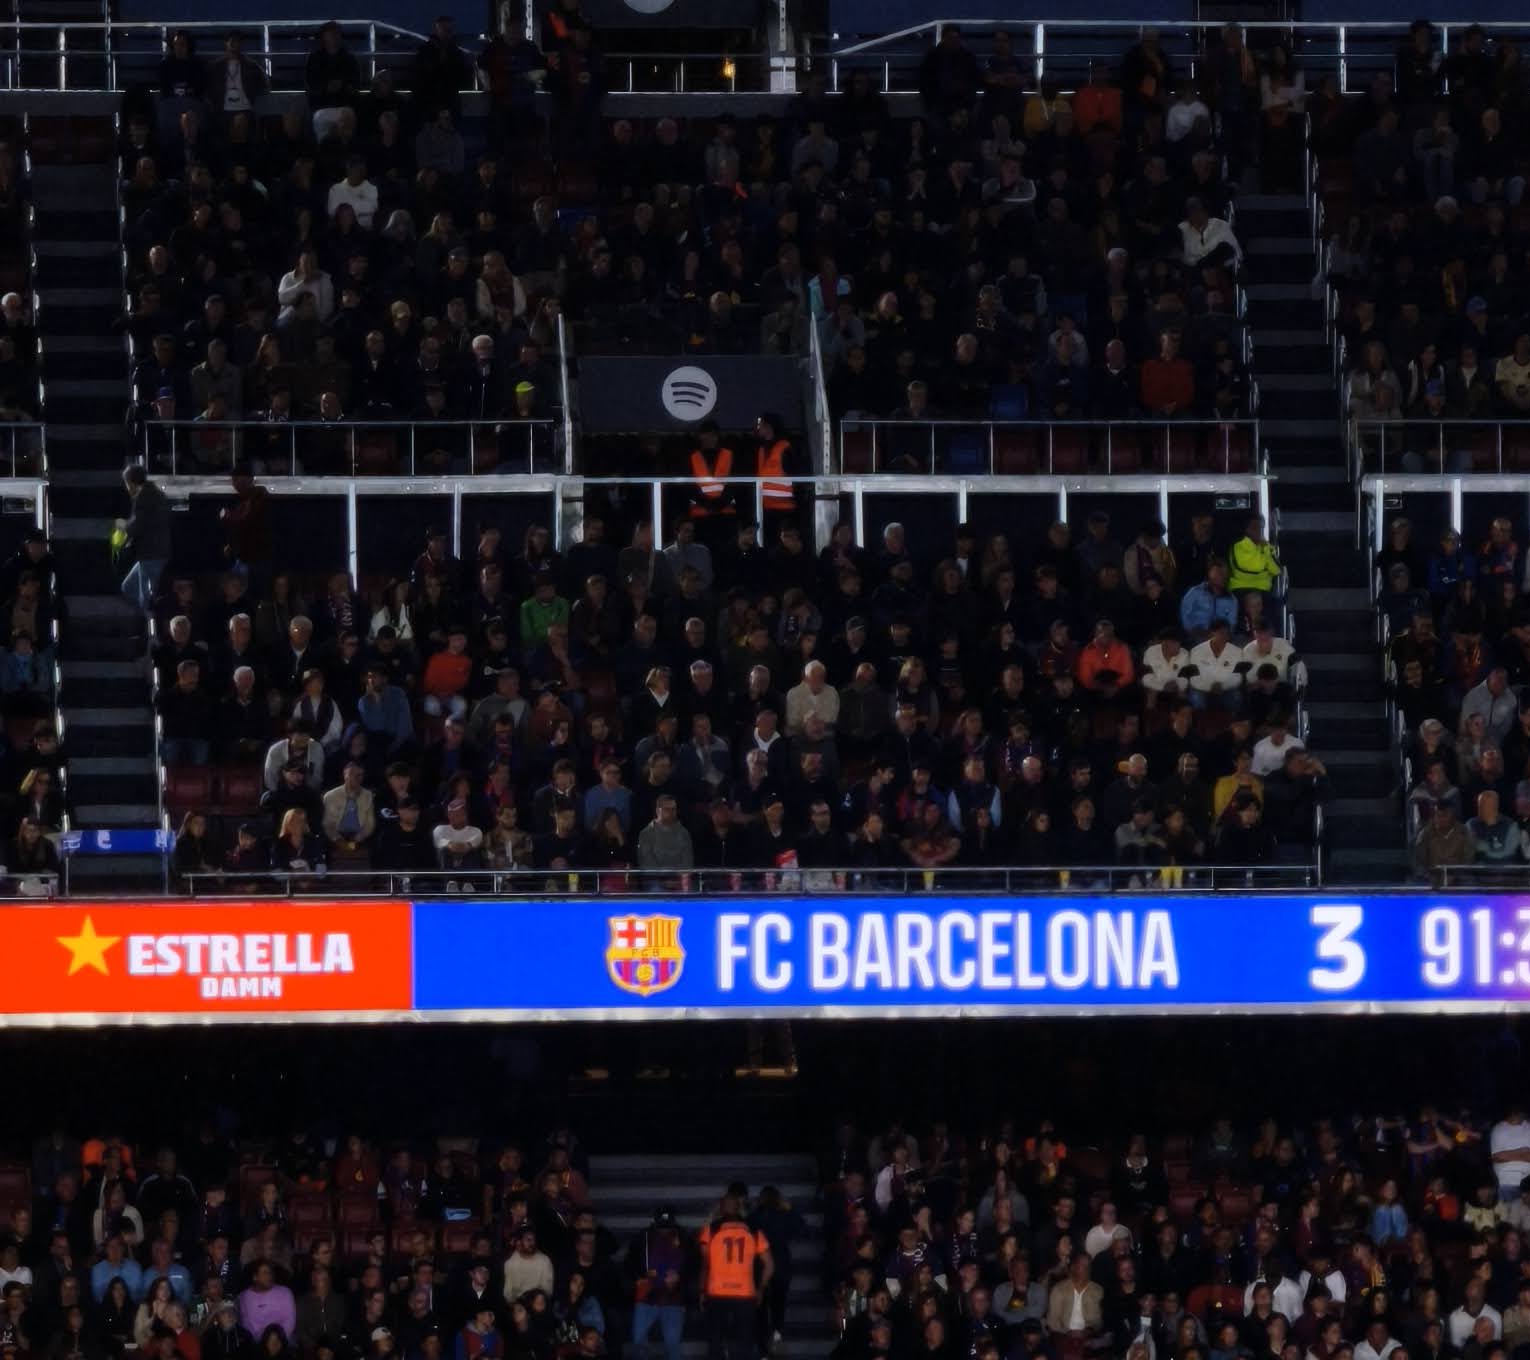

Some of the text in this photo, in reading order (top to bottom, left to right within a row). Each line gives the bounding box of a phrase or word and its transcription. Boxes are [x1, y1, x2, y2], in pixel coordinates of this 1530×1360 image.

[128, 933, 355, 976] ESTRELLA
[717, 910, 1179, 991] FC BARCELONA
[1310, 905, 1366, 991] 3
[201, 975, 283, 999] DAMM
